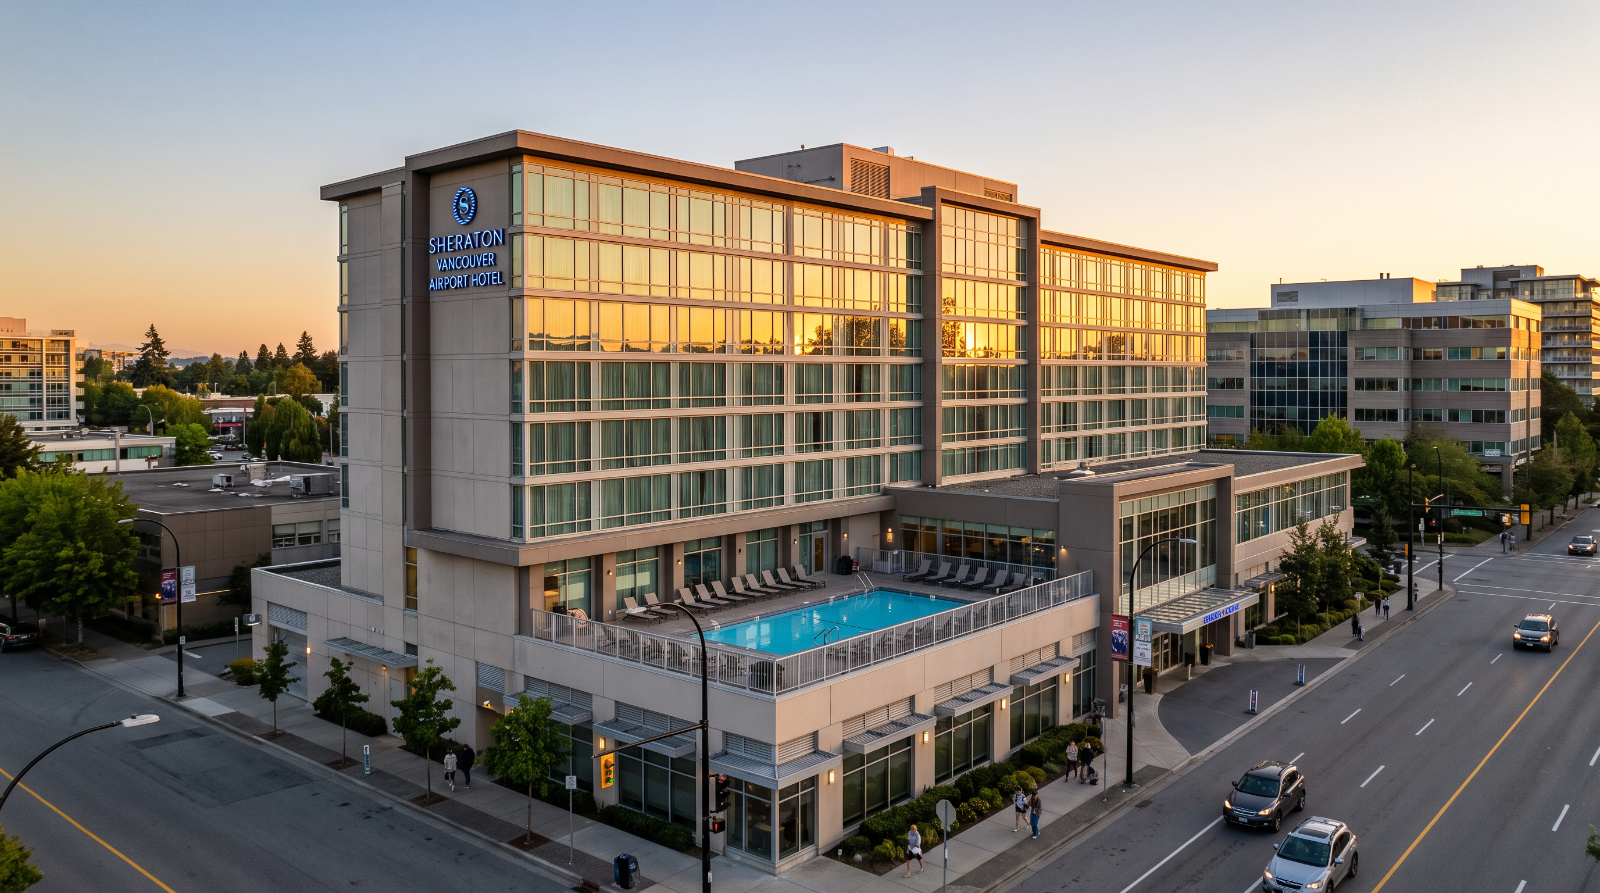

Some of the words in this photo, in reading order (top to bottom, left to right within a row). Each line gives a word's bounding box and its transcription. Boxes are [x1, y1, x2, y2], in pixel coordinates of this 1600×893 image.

[429, 228, 505, 254] SHERATON
[436, 252, 496, 272] VANCOUVER
[429, 274, 469, 291] AIRPORT
[471, 271, 505, 287] HOTEL
